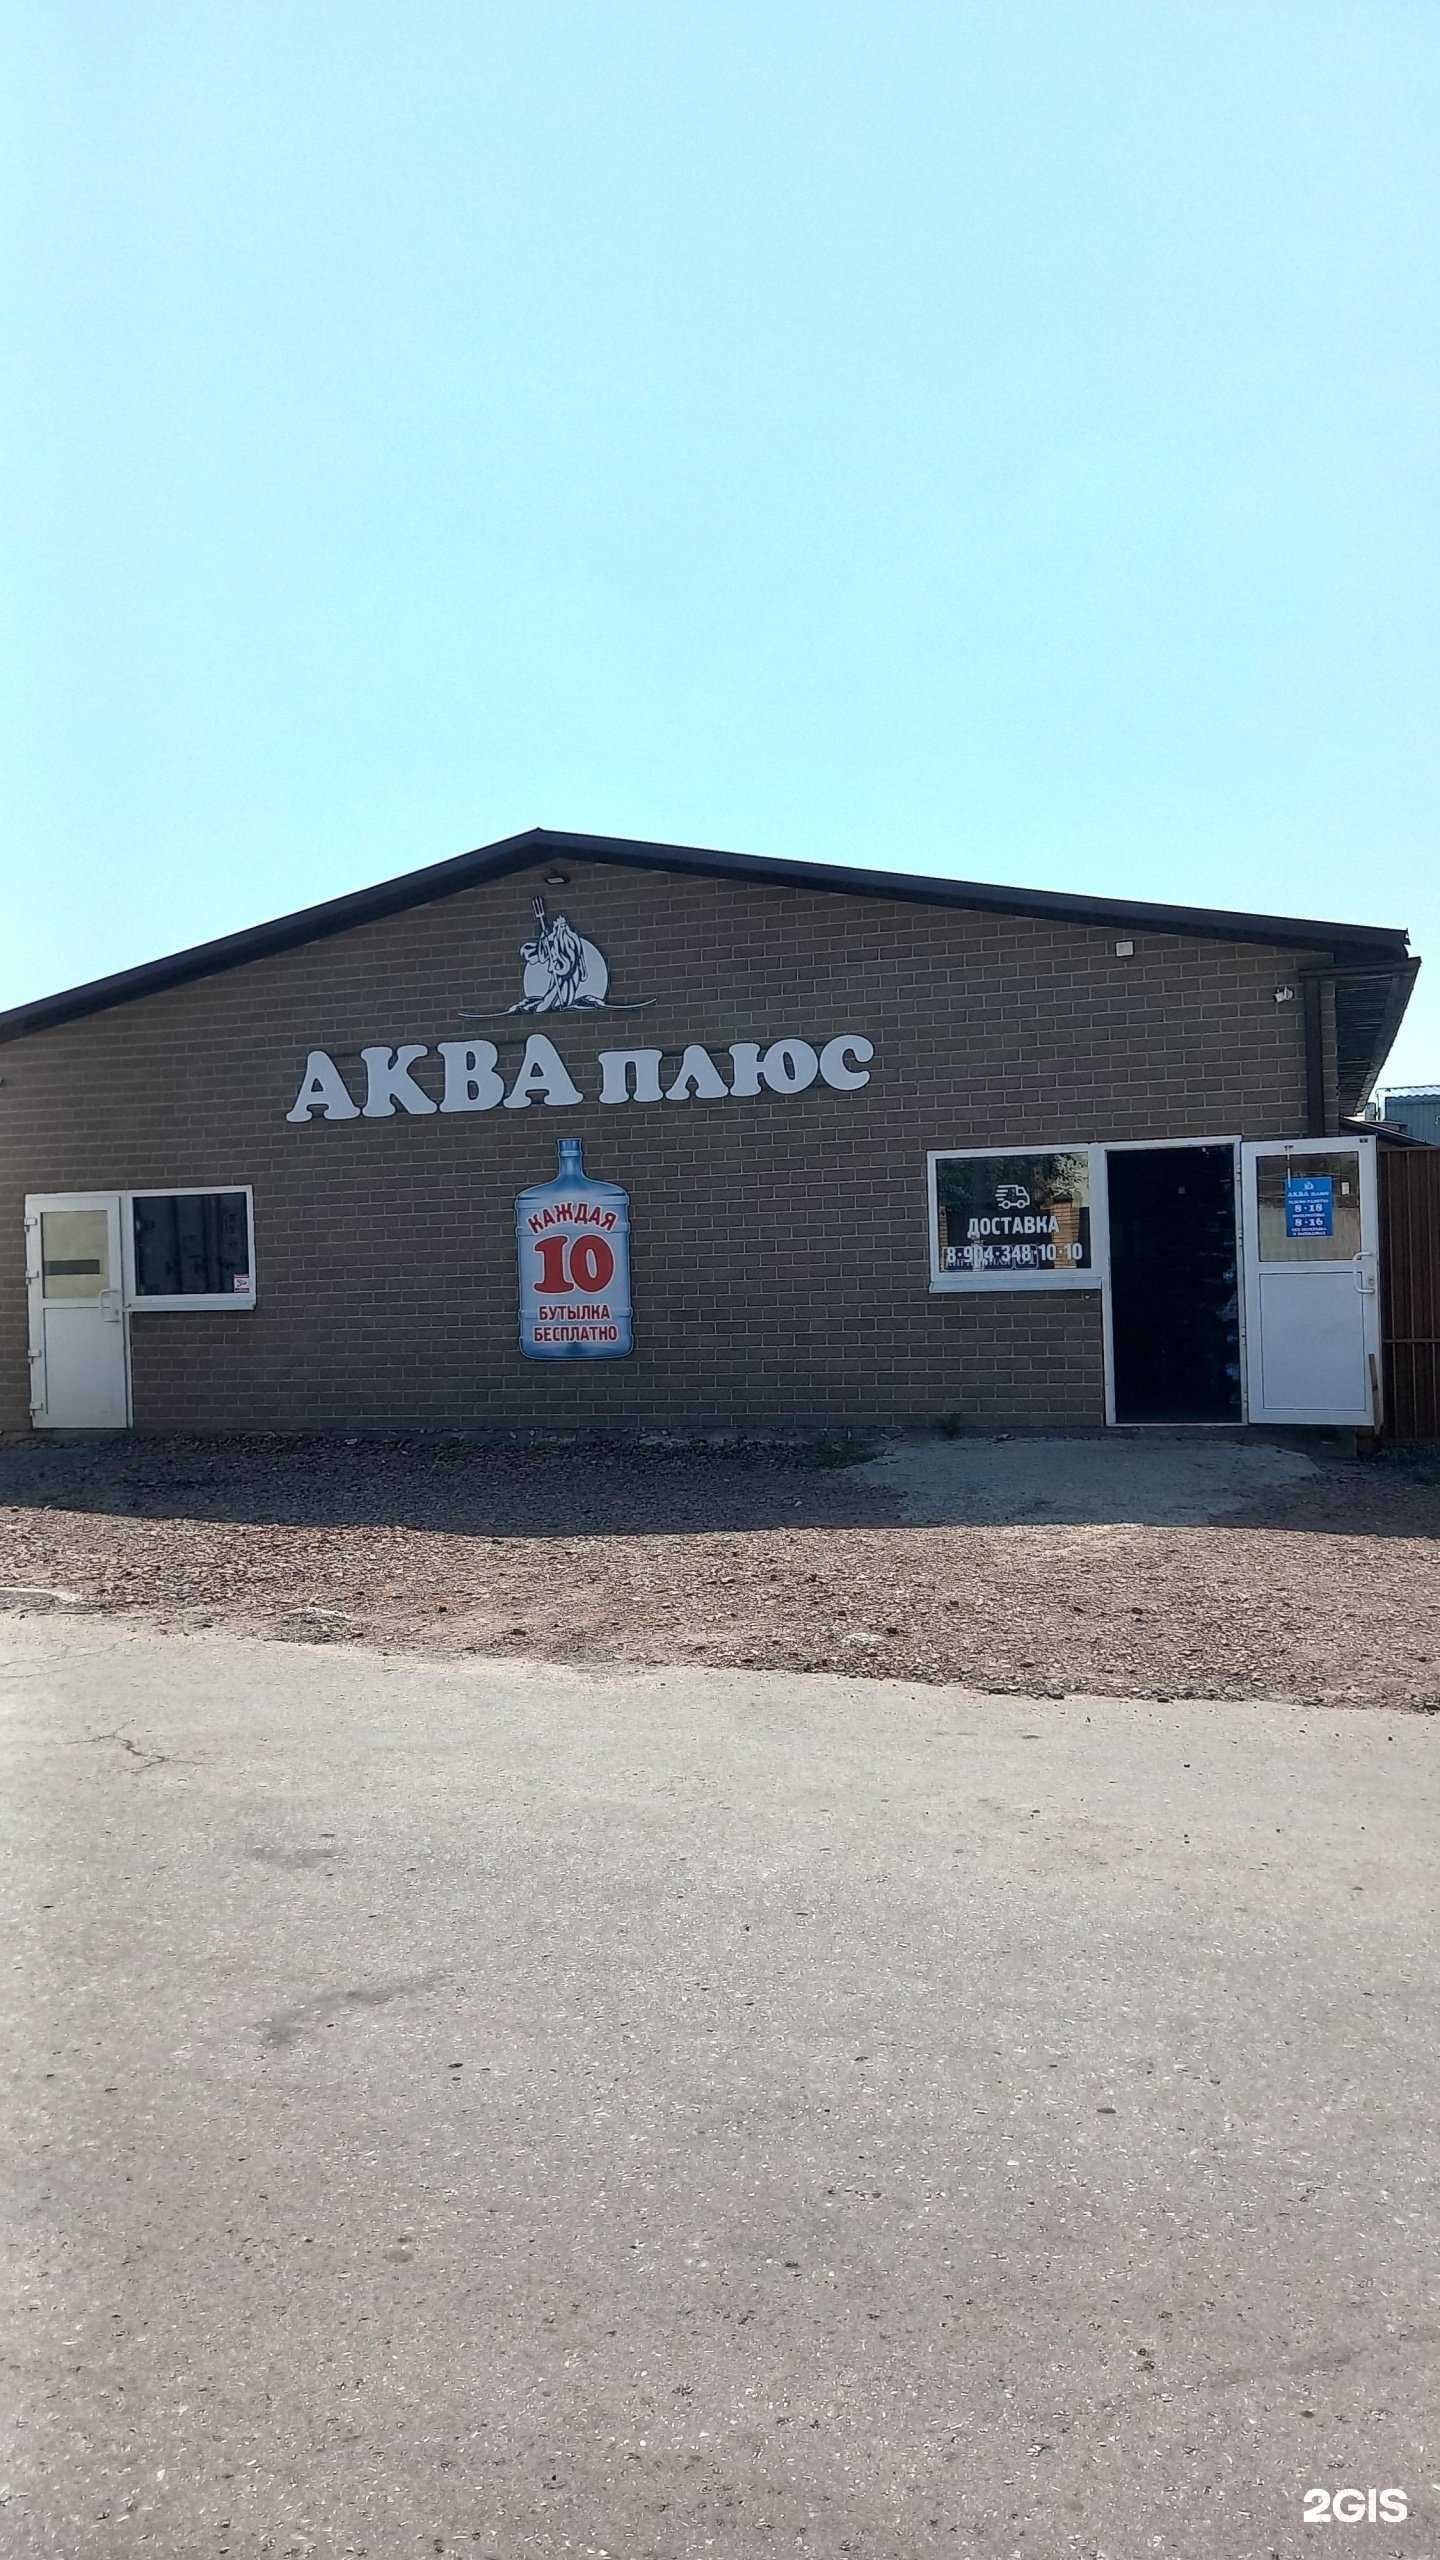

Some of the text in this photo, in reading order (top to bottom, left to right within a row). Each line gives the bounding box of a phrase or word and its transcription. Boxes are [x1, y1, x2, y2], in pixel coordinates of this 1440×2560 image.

[286, 1033, 584, 1123] АКВА
[528, 1202, 617, 1234] КАЖДАЯ
[967, 1215, 1060, 1238] ДОСТАВКА
[533, 1233, 615, 1294] 10
[539, 1304, 611, 1322] БУТЫЛКА
[534, 1325, 618, 1343] БЕСПЛАТНО
